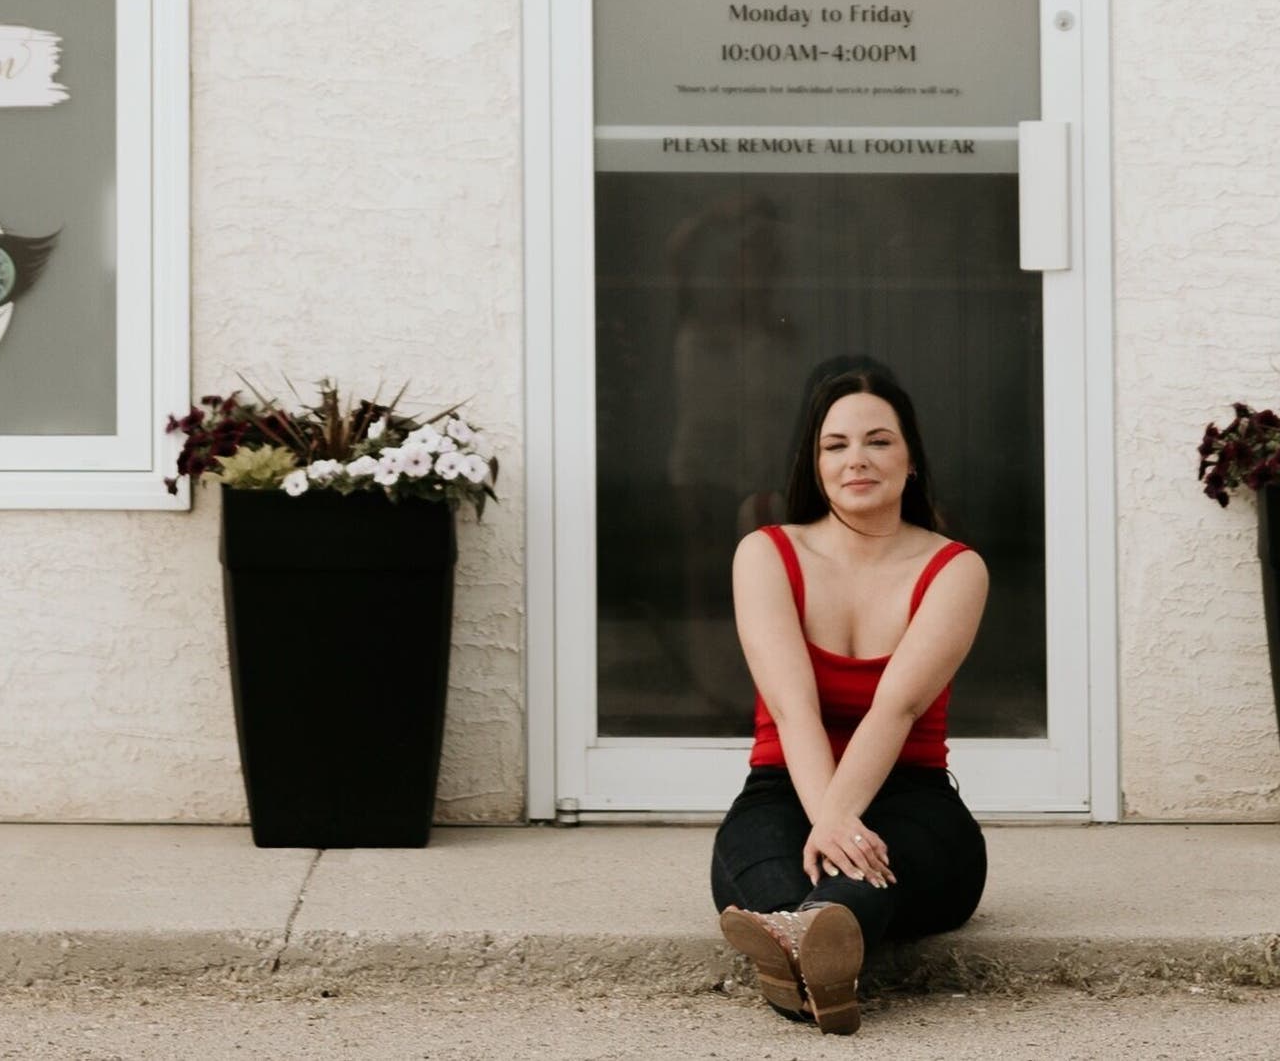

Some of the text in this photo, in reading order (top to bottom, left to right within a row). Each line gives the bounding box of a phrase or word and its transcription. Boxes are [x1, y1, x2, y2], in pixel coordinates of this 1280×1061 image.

[728, 4, 915, 28] Monday to Friday
[720, 43, 918, 64] 10:00AM-4:00PM
[662, 137, 975, 155] PLEASE REMOVE ALL FOOTWEAR
